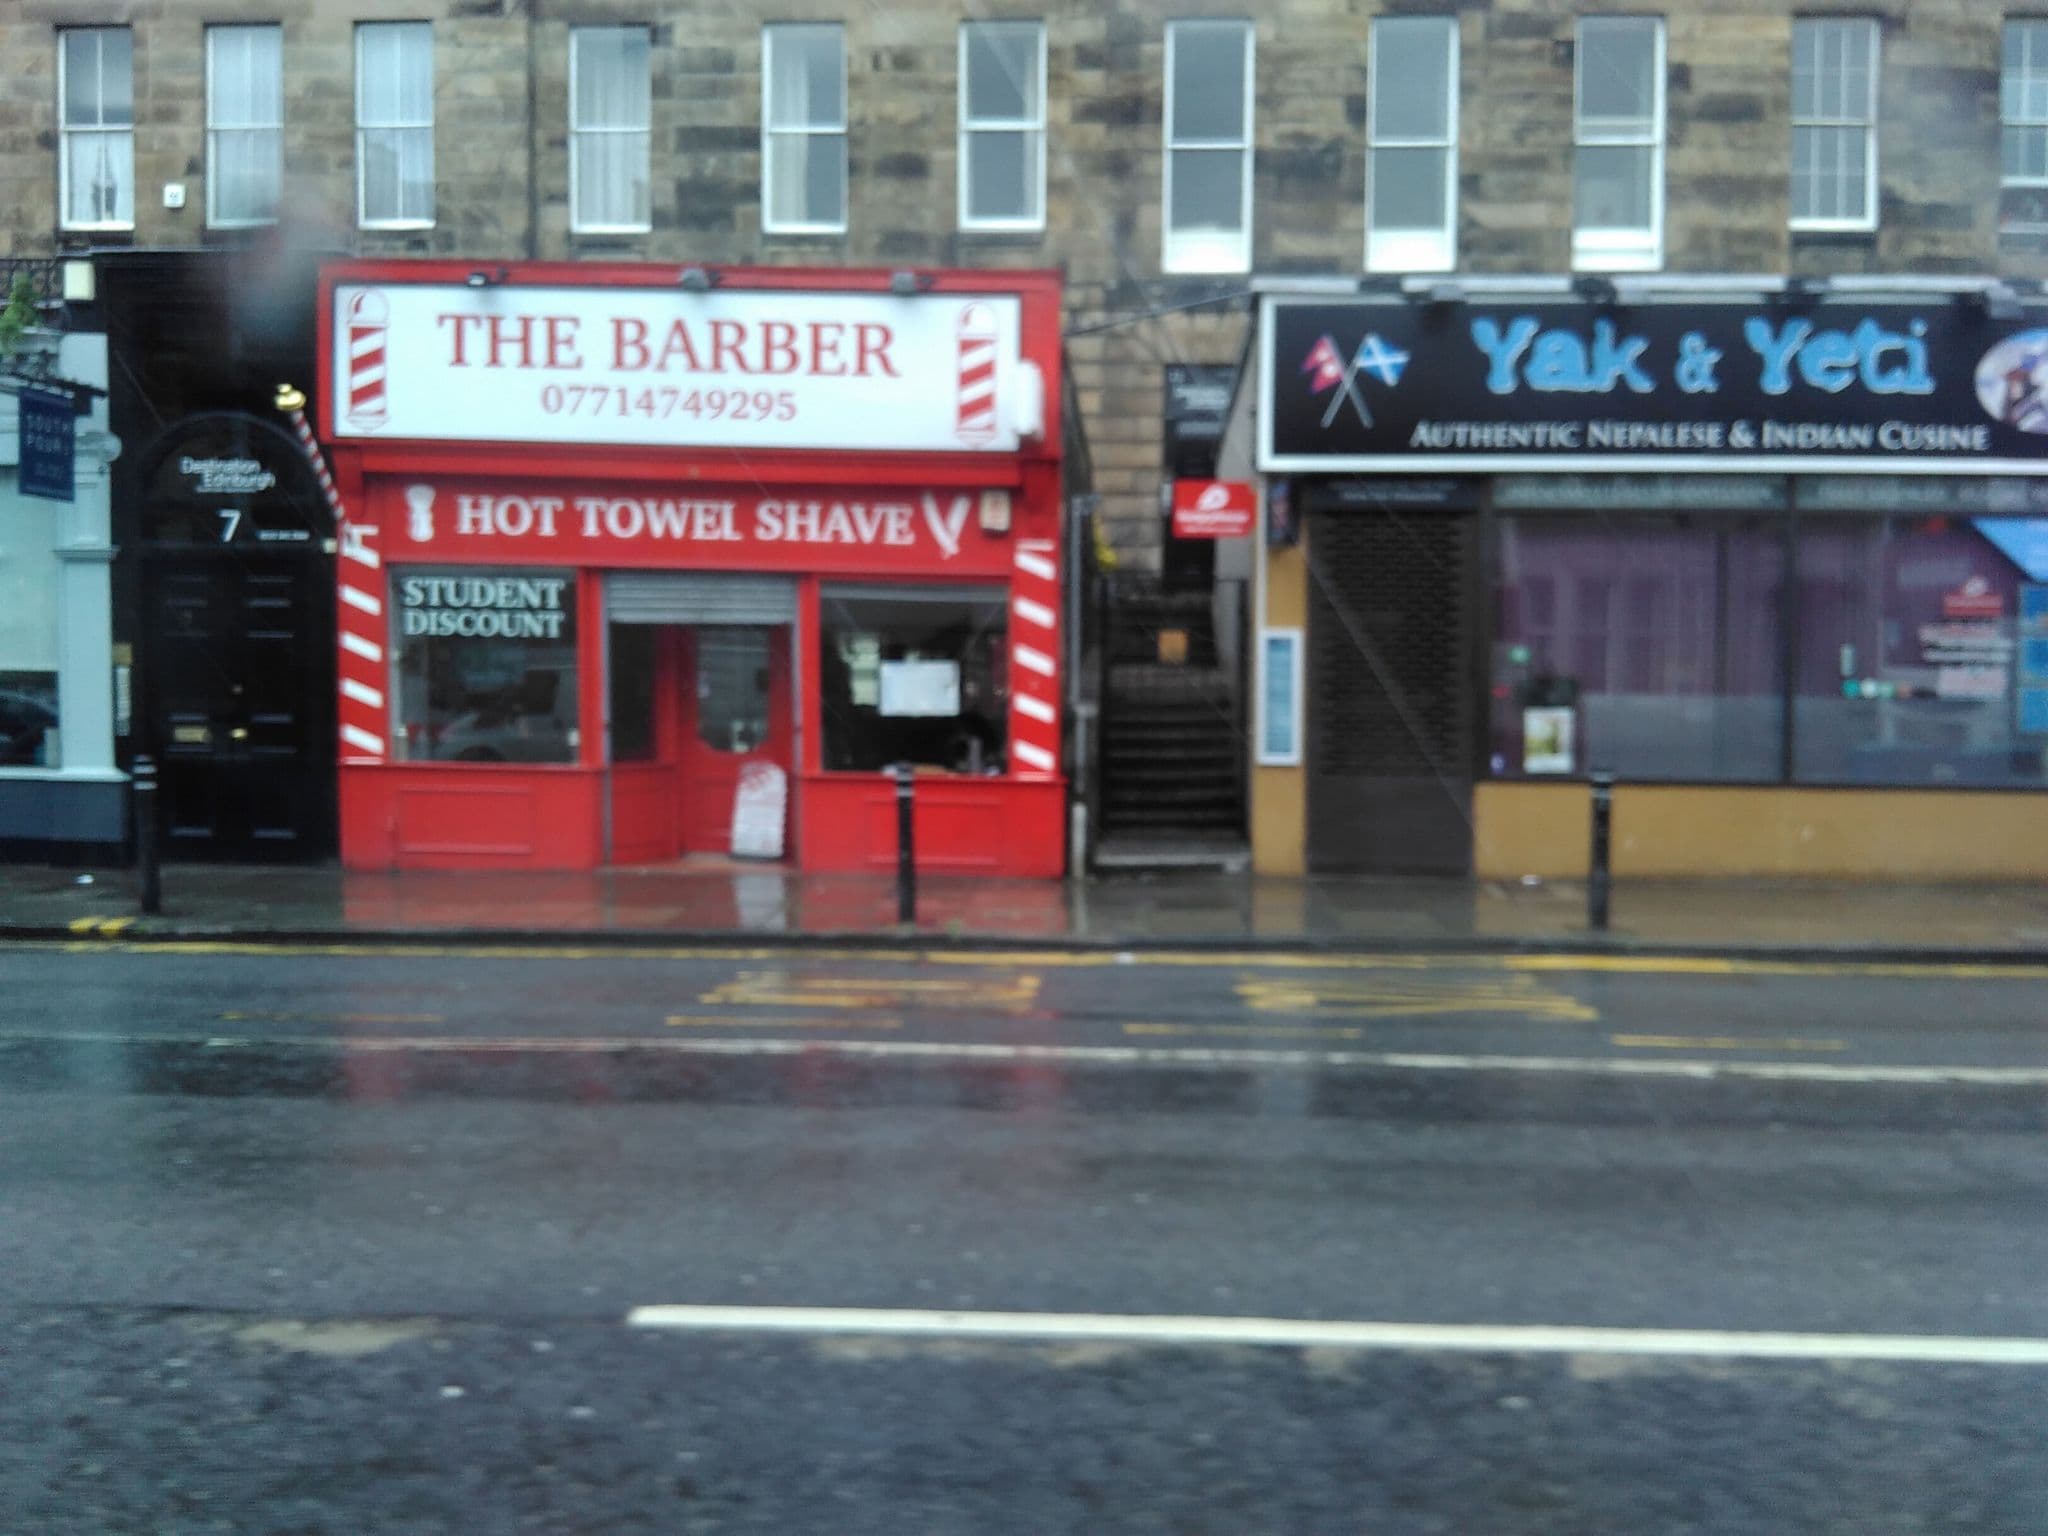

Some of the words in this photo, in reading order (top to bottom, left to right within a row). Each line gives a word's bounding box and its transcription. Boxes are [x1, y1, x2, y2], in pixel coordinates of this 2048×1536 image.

[438, 316, 582, 369] THE
[612, 318, 901, 378] BARBER
[1470, 318, 1656, 395] Yak
[1675, 332, 1724, 394] &
[1745, 317, 1937, 395] Yeti
[541, 384, 797, 423] 07714749295
[1411, 420, 1580, 450] AUTHENTIC
[1730, 421, 1756, 450] &
[1763, 421, 1872, 452] INDIAN
[1880, 423, 1990, 455] CUSINE
[217, 508, 242, 543] 7
[456, 493, 564, 540] HOT
[576, 496, 743, 543] TOWEL
[756, 502, 915, 549] SHAVE
[402, 578, 566, 609] STUDENT
[404, 610, 566, 641] DISCOUNT
